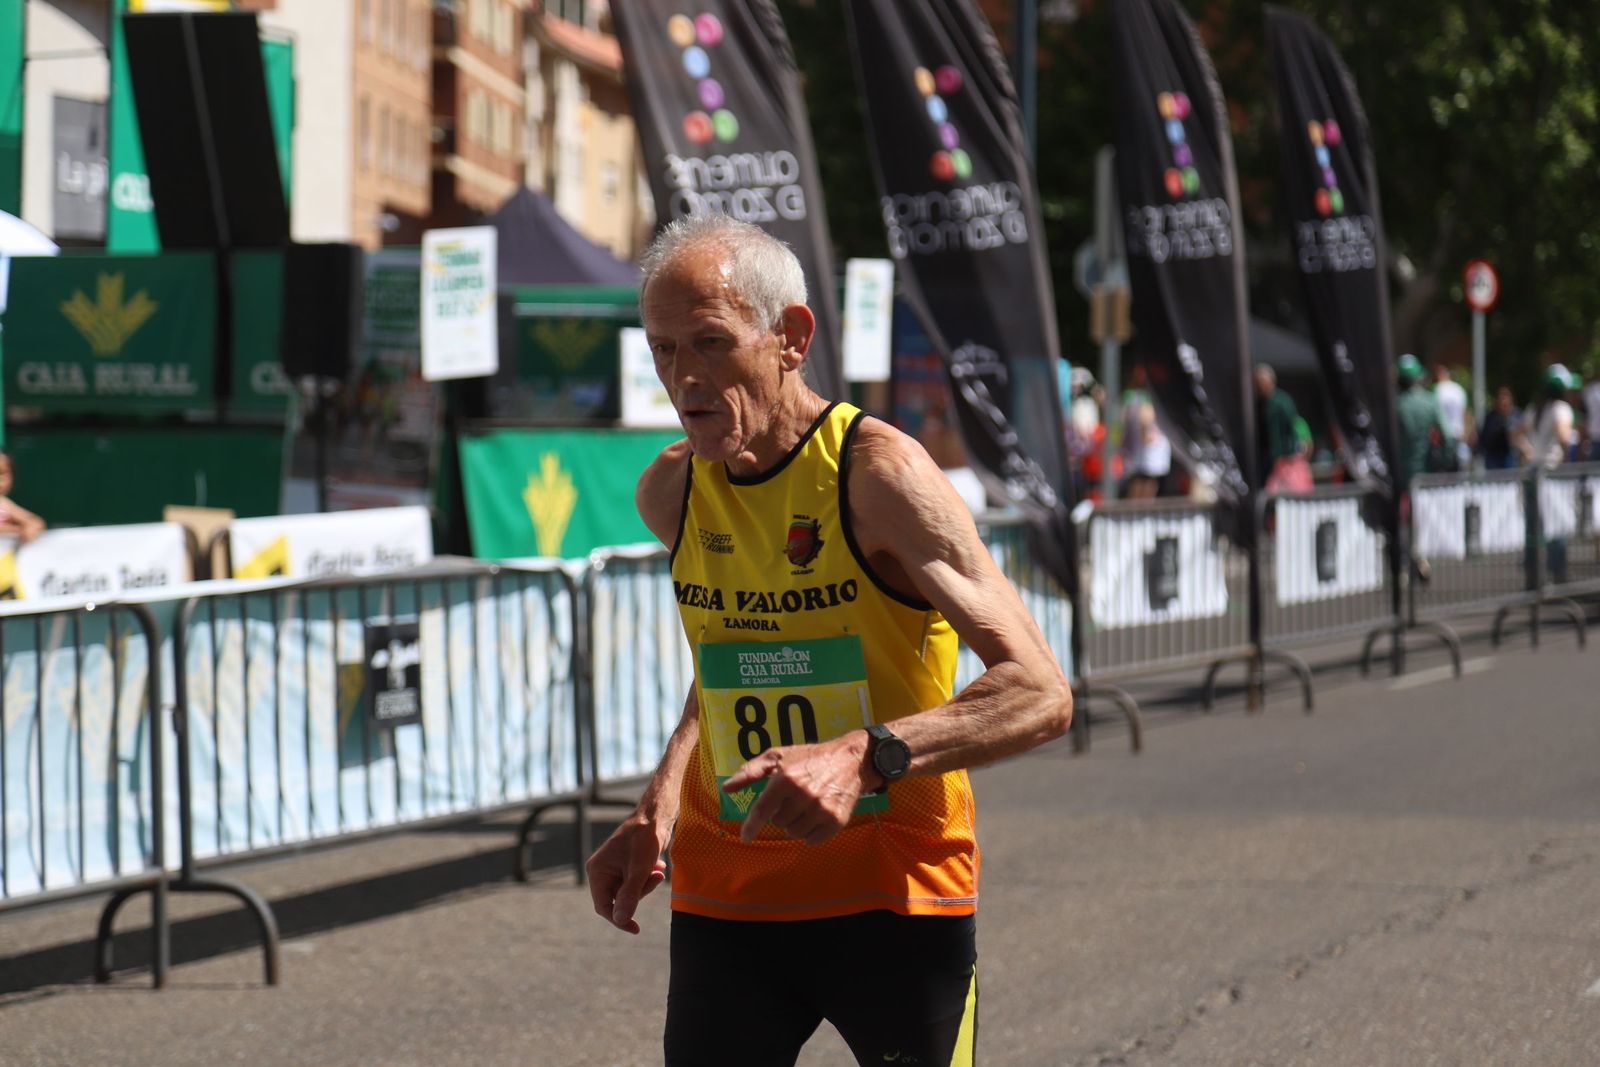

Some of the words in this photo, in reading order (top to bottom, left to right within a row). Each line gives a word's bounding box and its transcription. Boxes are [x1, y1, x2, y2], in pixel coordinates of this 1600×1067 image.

[17, 361, 87, 395] CAJA
[94, 361, 198, 396] RURAL
[673, 581, 725, 611] MESA
[735, 578, 858, 613] VALORIO
[722, 617, 781, 632] ZAMORA
[740, 664, 769, 677] CAJA
[770, 662, 813, 675] RURAL
[741, 677, 751, 686] DE
[752, 677, 781, 685] ZAMORA
[734, 694, 819, 762] 80
